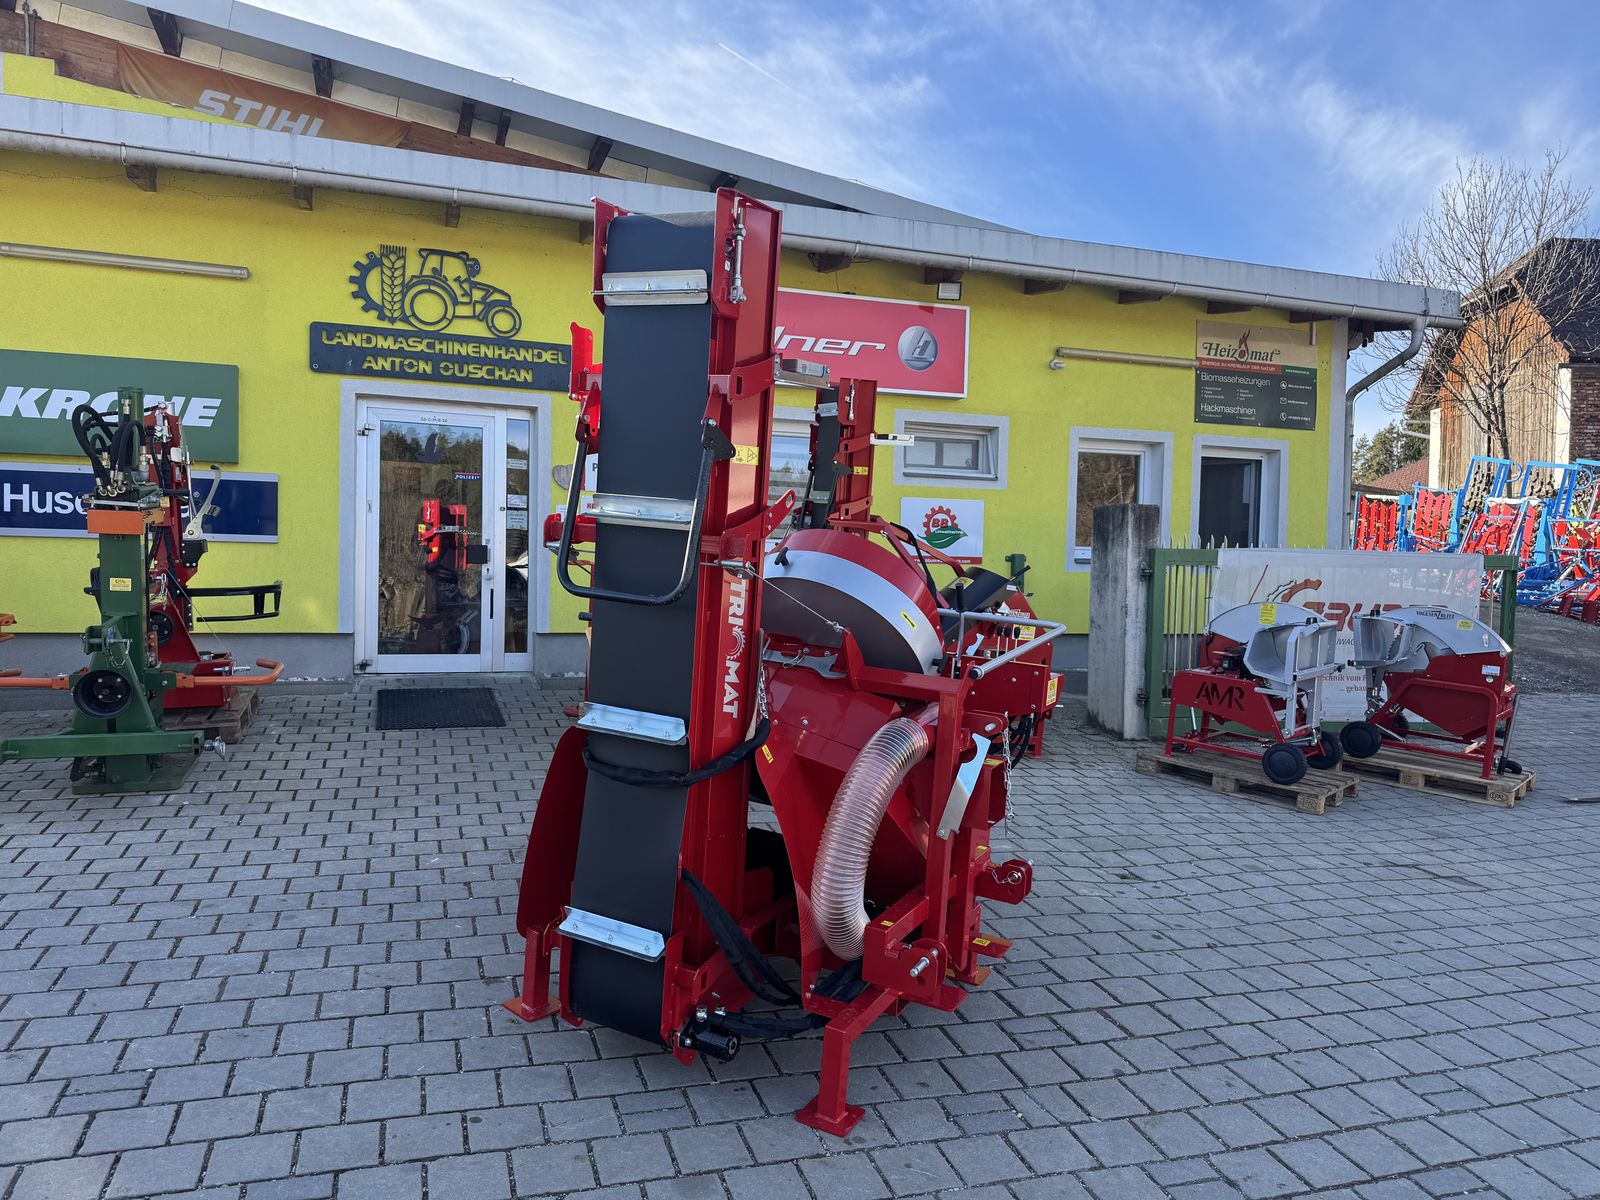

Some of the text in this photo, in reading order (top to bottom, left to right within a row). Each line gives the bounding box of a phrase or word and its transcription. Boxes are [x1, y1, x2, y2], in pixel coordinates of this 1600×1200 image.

[321, 328, 568, 366] LANDMASCHINENHANDEL
[361, 355, 534, 383] ANTON OUSCHAN
[1200, 371, 1271, 388] Biomasseheizungen
[1200, 402, 1256, 415] Hackmaschinen
[1195, 681, 1246, 711] AMR
